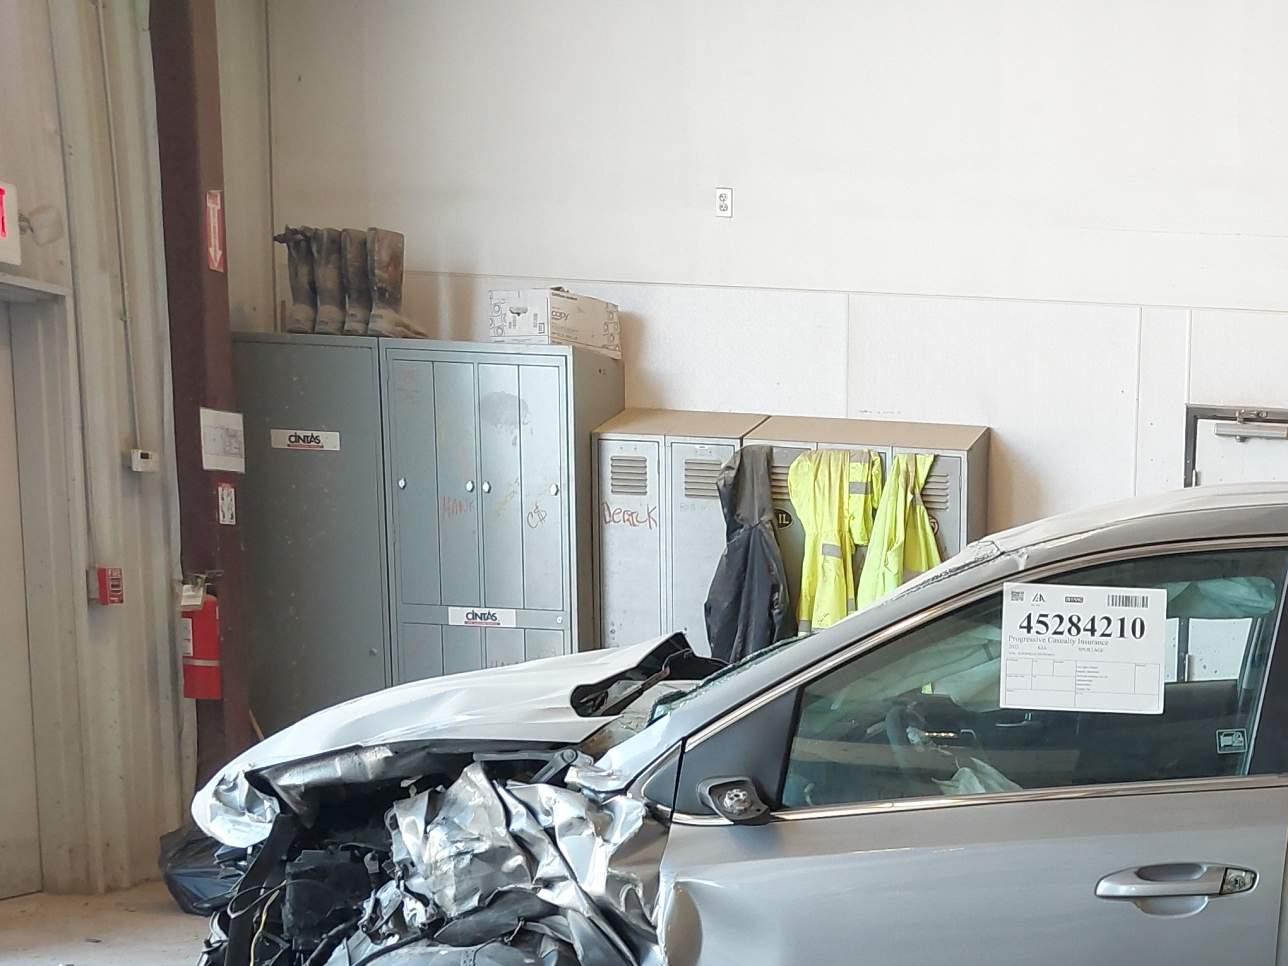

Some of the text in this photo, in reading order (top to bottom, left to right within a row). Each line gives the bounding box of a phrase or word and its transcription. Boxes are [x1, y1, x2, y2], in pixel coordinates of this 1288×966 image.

[288, 432, 321, 444] CINTAS
[465, 610, 498, 621] CINTAS
[1019, 612, 1146, 640] 45284210
